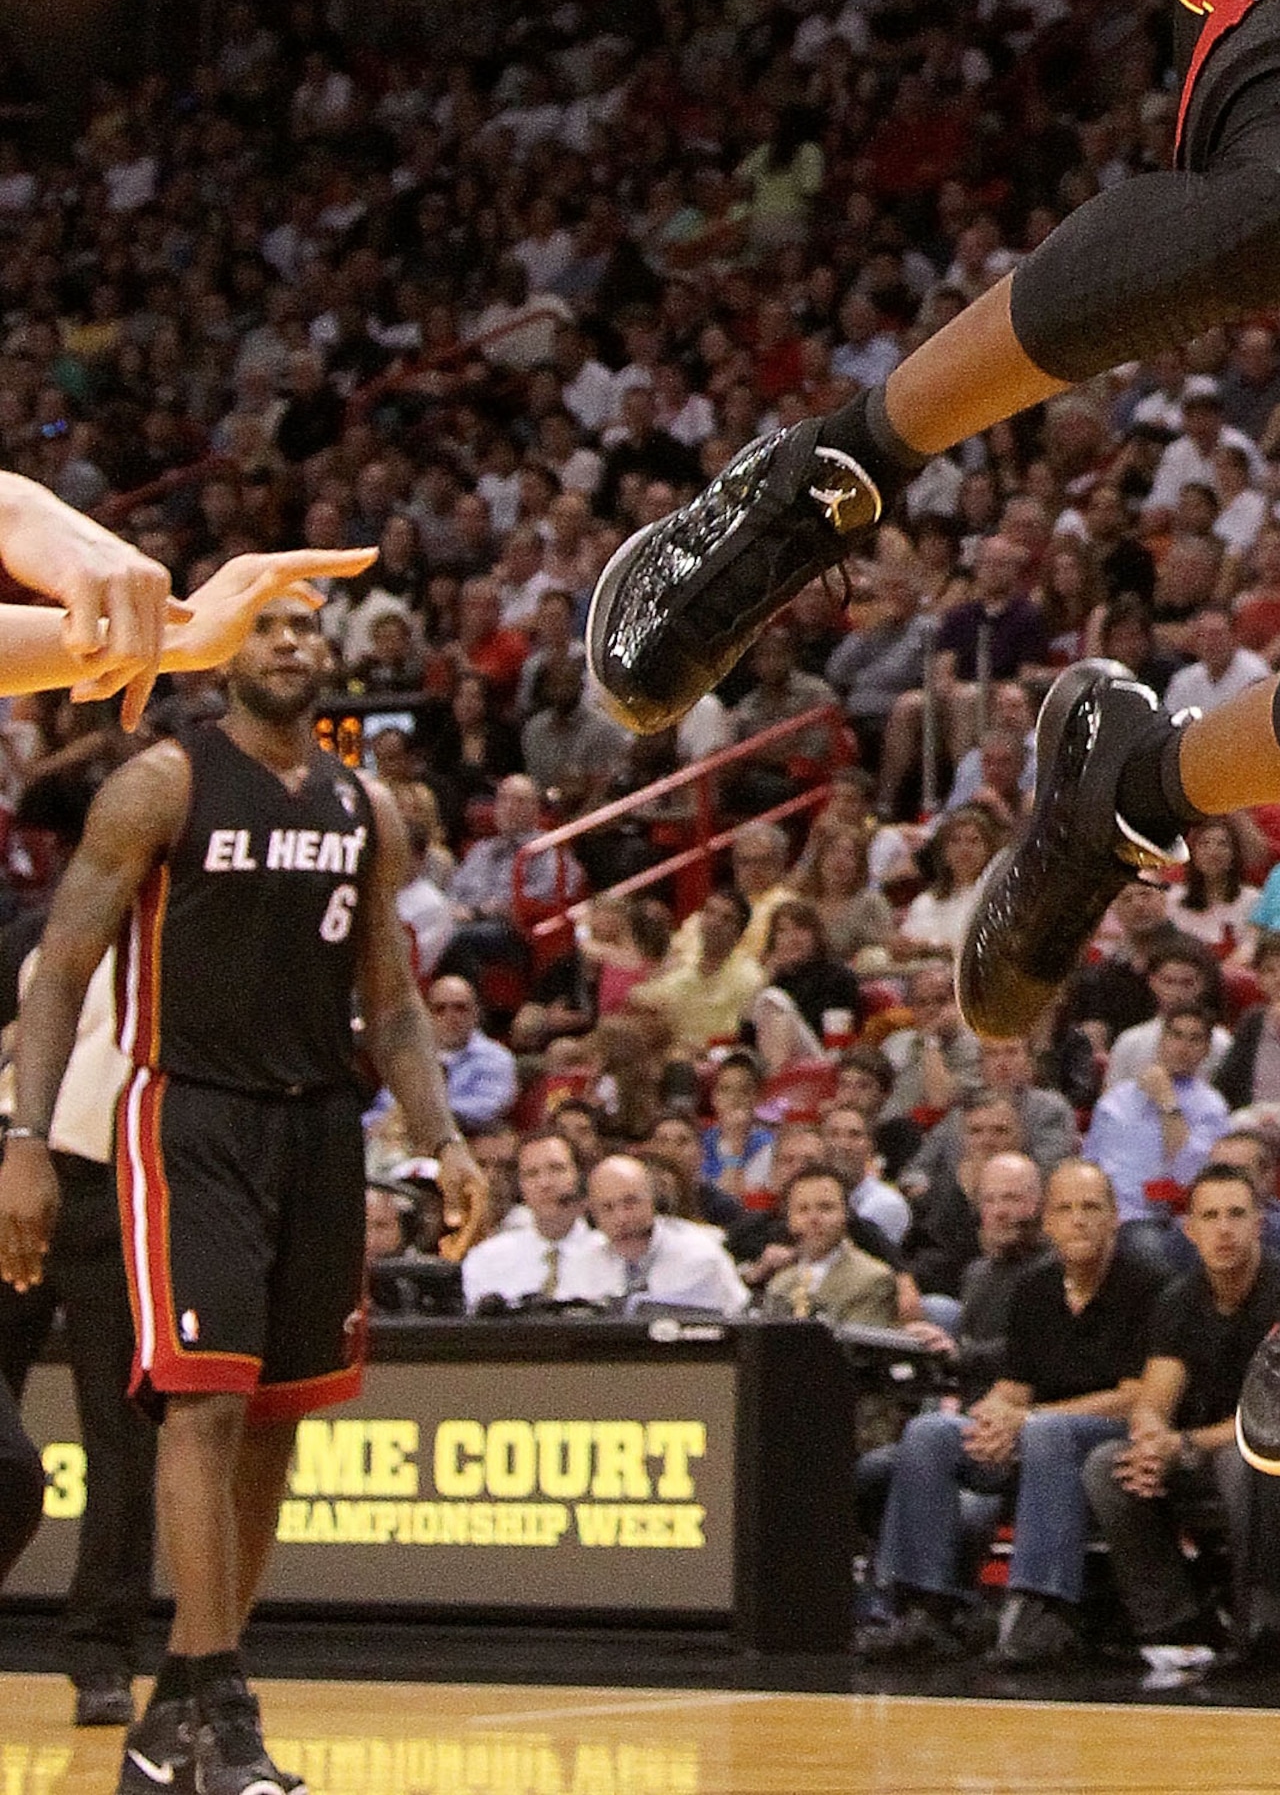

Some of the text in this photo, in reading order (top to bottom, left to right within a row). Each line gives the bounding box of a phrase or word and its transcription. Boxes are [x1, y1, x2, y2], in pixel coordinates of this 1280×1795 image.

[203, 825, 368, 875] EL HEAT
[318, 883, 359, 943] 6
[289, 1418, 420, 1497] ME
[433, 1419, 707, 1500] COURT
[275, 1499, 707, 1550] HAMPIONSHIP WEEK
